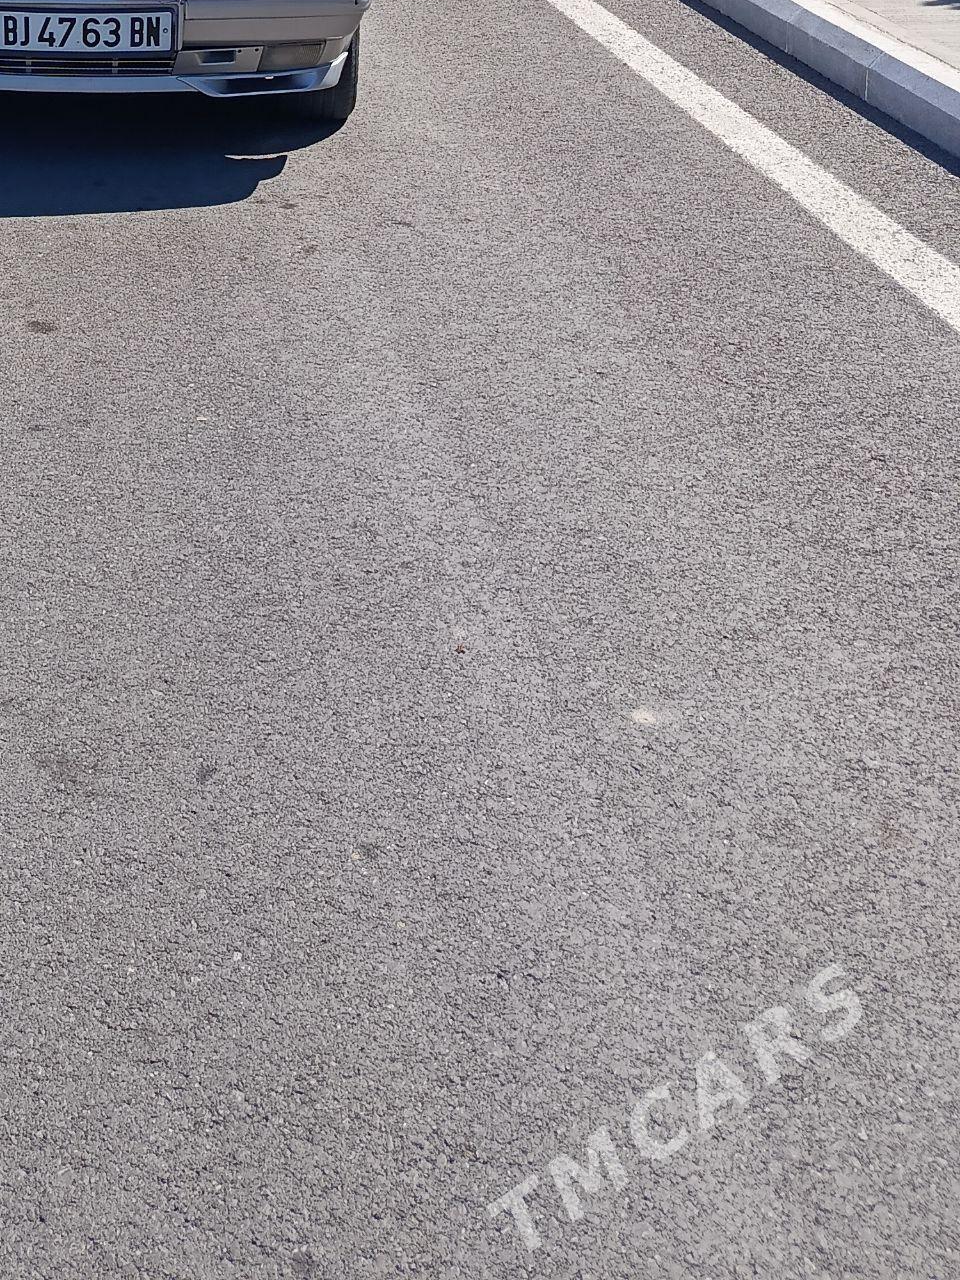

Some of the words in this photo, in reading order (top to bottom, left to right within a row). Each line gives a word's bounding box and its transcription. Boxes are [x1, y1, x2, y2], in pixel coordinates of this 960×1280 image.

[3, 16, 30, 46] BJ
[38, 17, 121, 47] 4763
[130, 17, 161, 47] BN
